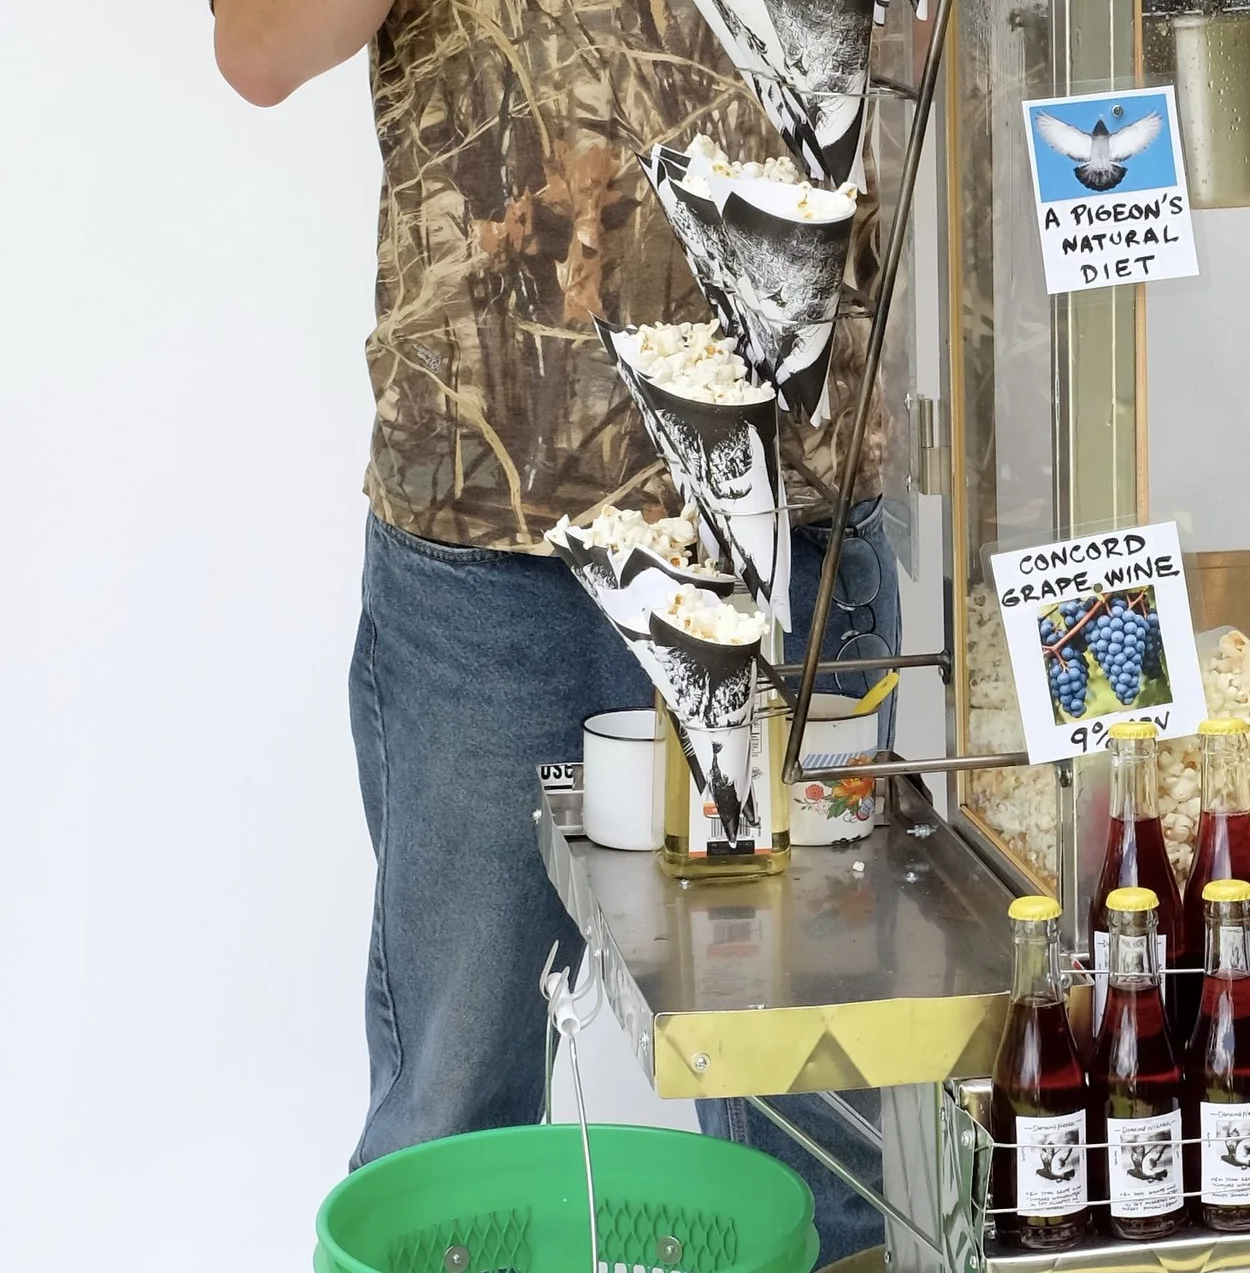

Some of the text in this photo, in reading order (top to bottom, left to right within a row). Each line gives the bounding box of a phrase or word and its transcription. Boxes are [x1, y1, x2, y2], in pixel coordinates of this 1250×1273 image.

[1044, 193, 1184, 231] A PIGEON'S
[1062, 225, 1180, 256] NATURAL
[1080, 254, 1156, 284] DIET
[1019, 534, 1147, 575] CONCORD
[1001, 555, 1181, 607] GRAPE WINE
